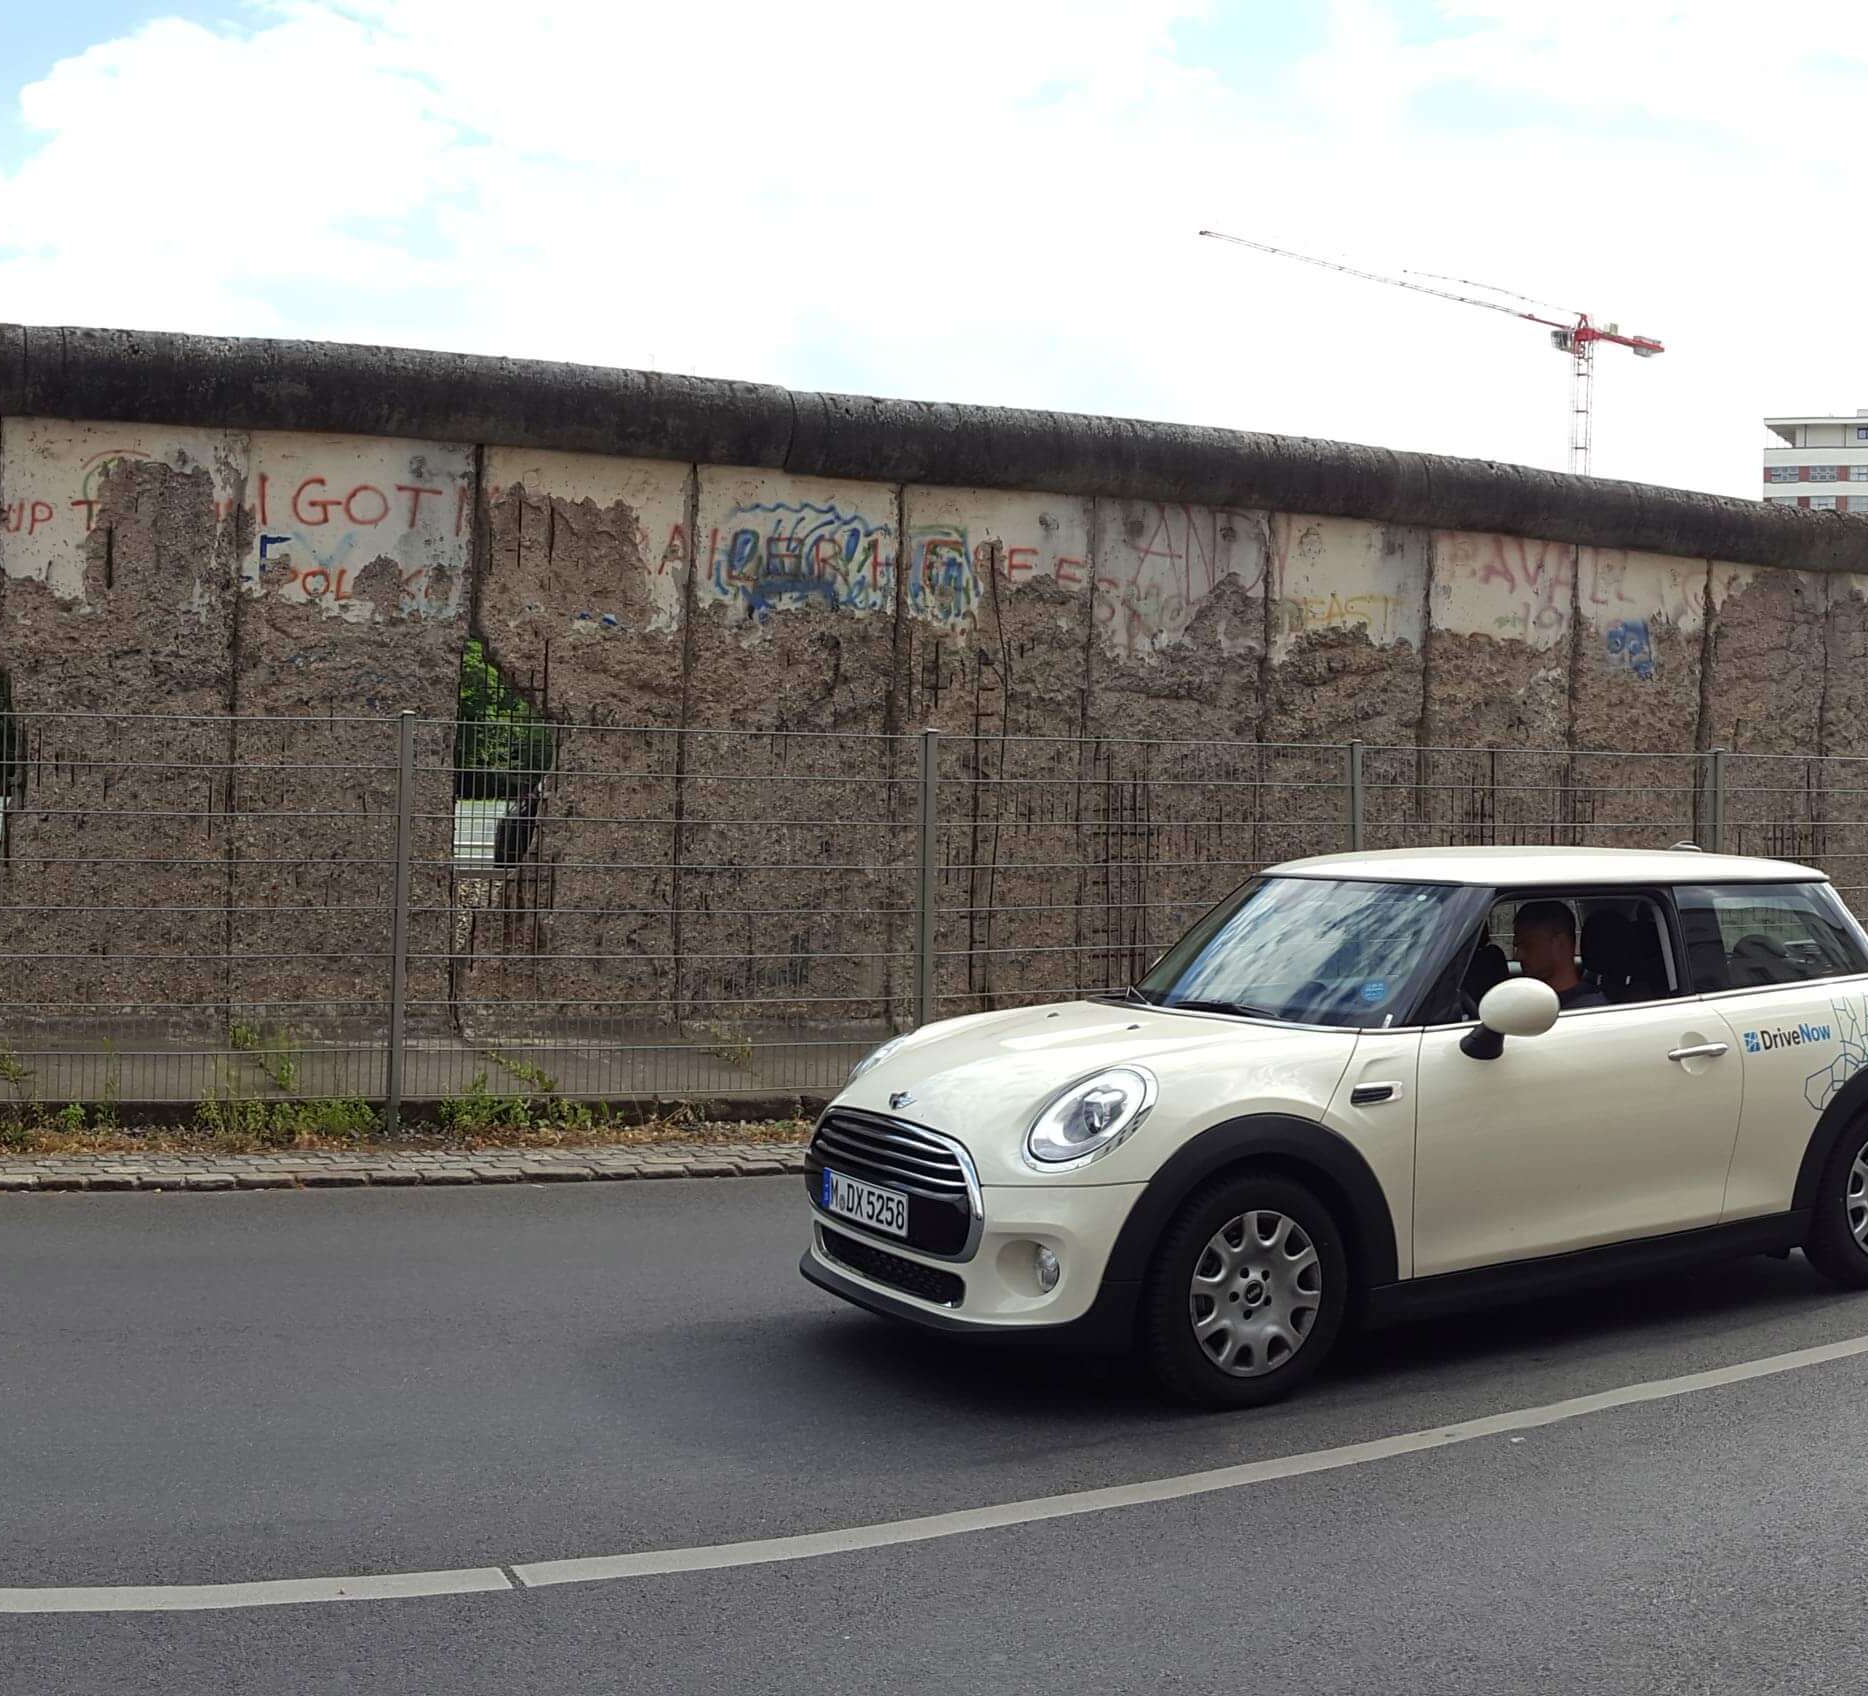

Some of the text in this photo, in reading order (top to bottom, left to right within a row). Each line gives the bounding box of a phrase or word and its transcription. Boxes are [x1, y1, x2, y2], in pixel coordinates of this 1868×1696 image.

[6, 499, 54, 536] UP
[292, 476, 444, 529] GOT
[1760, 1023, 1832, 1050] DriveNow
[830, 1174, 905, 1231] M DX 5258
